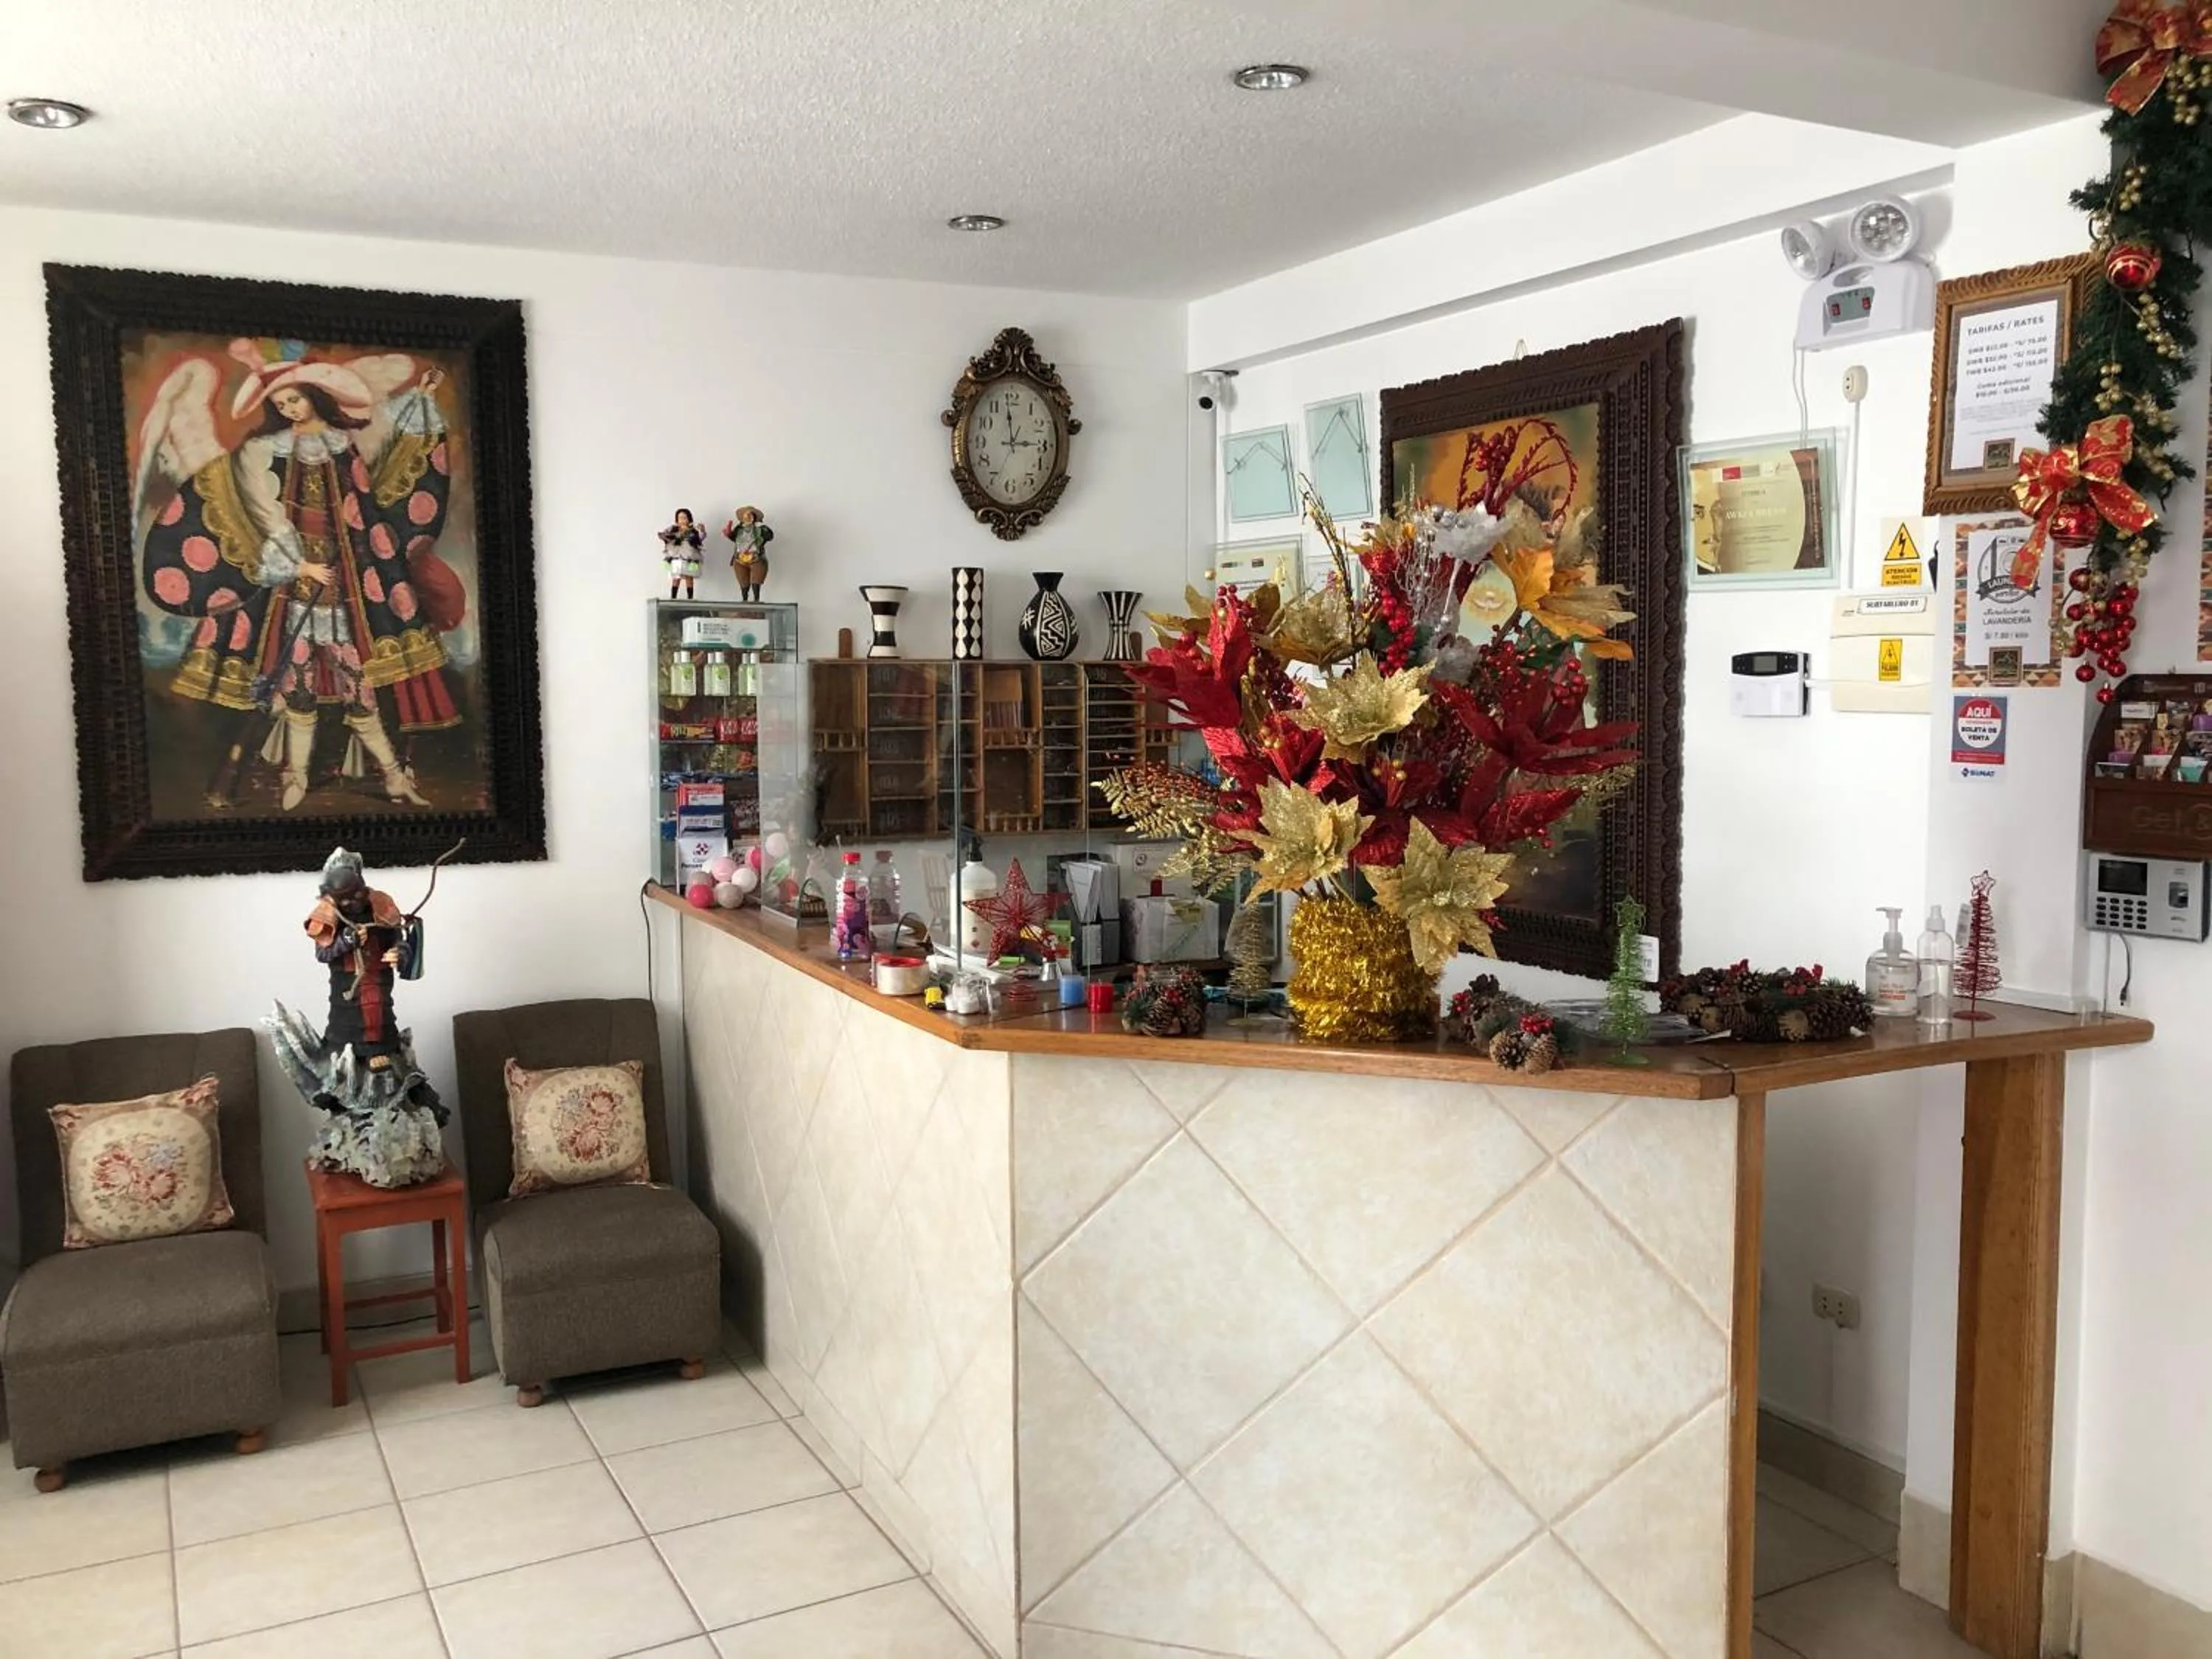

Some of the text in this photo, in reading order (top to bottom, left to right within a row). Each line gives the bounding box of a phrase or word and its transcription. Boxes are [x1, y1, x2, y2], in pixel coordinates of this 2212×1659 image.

[1968, 321, 2005, 336] TARIFAS
[2014, 315, 2044, 328] RATES
[990, 400, 999, 414] 11
[1029, 402, 1033, 416] 1
[978, 416, 993, 431] 10
[1034, 418, 1045, 433] 2
[978, 453, 990, 467] 8
[1004, 478, 1016, 494] 6
